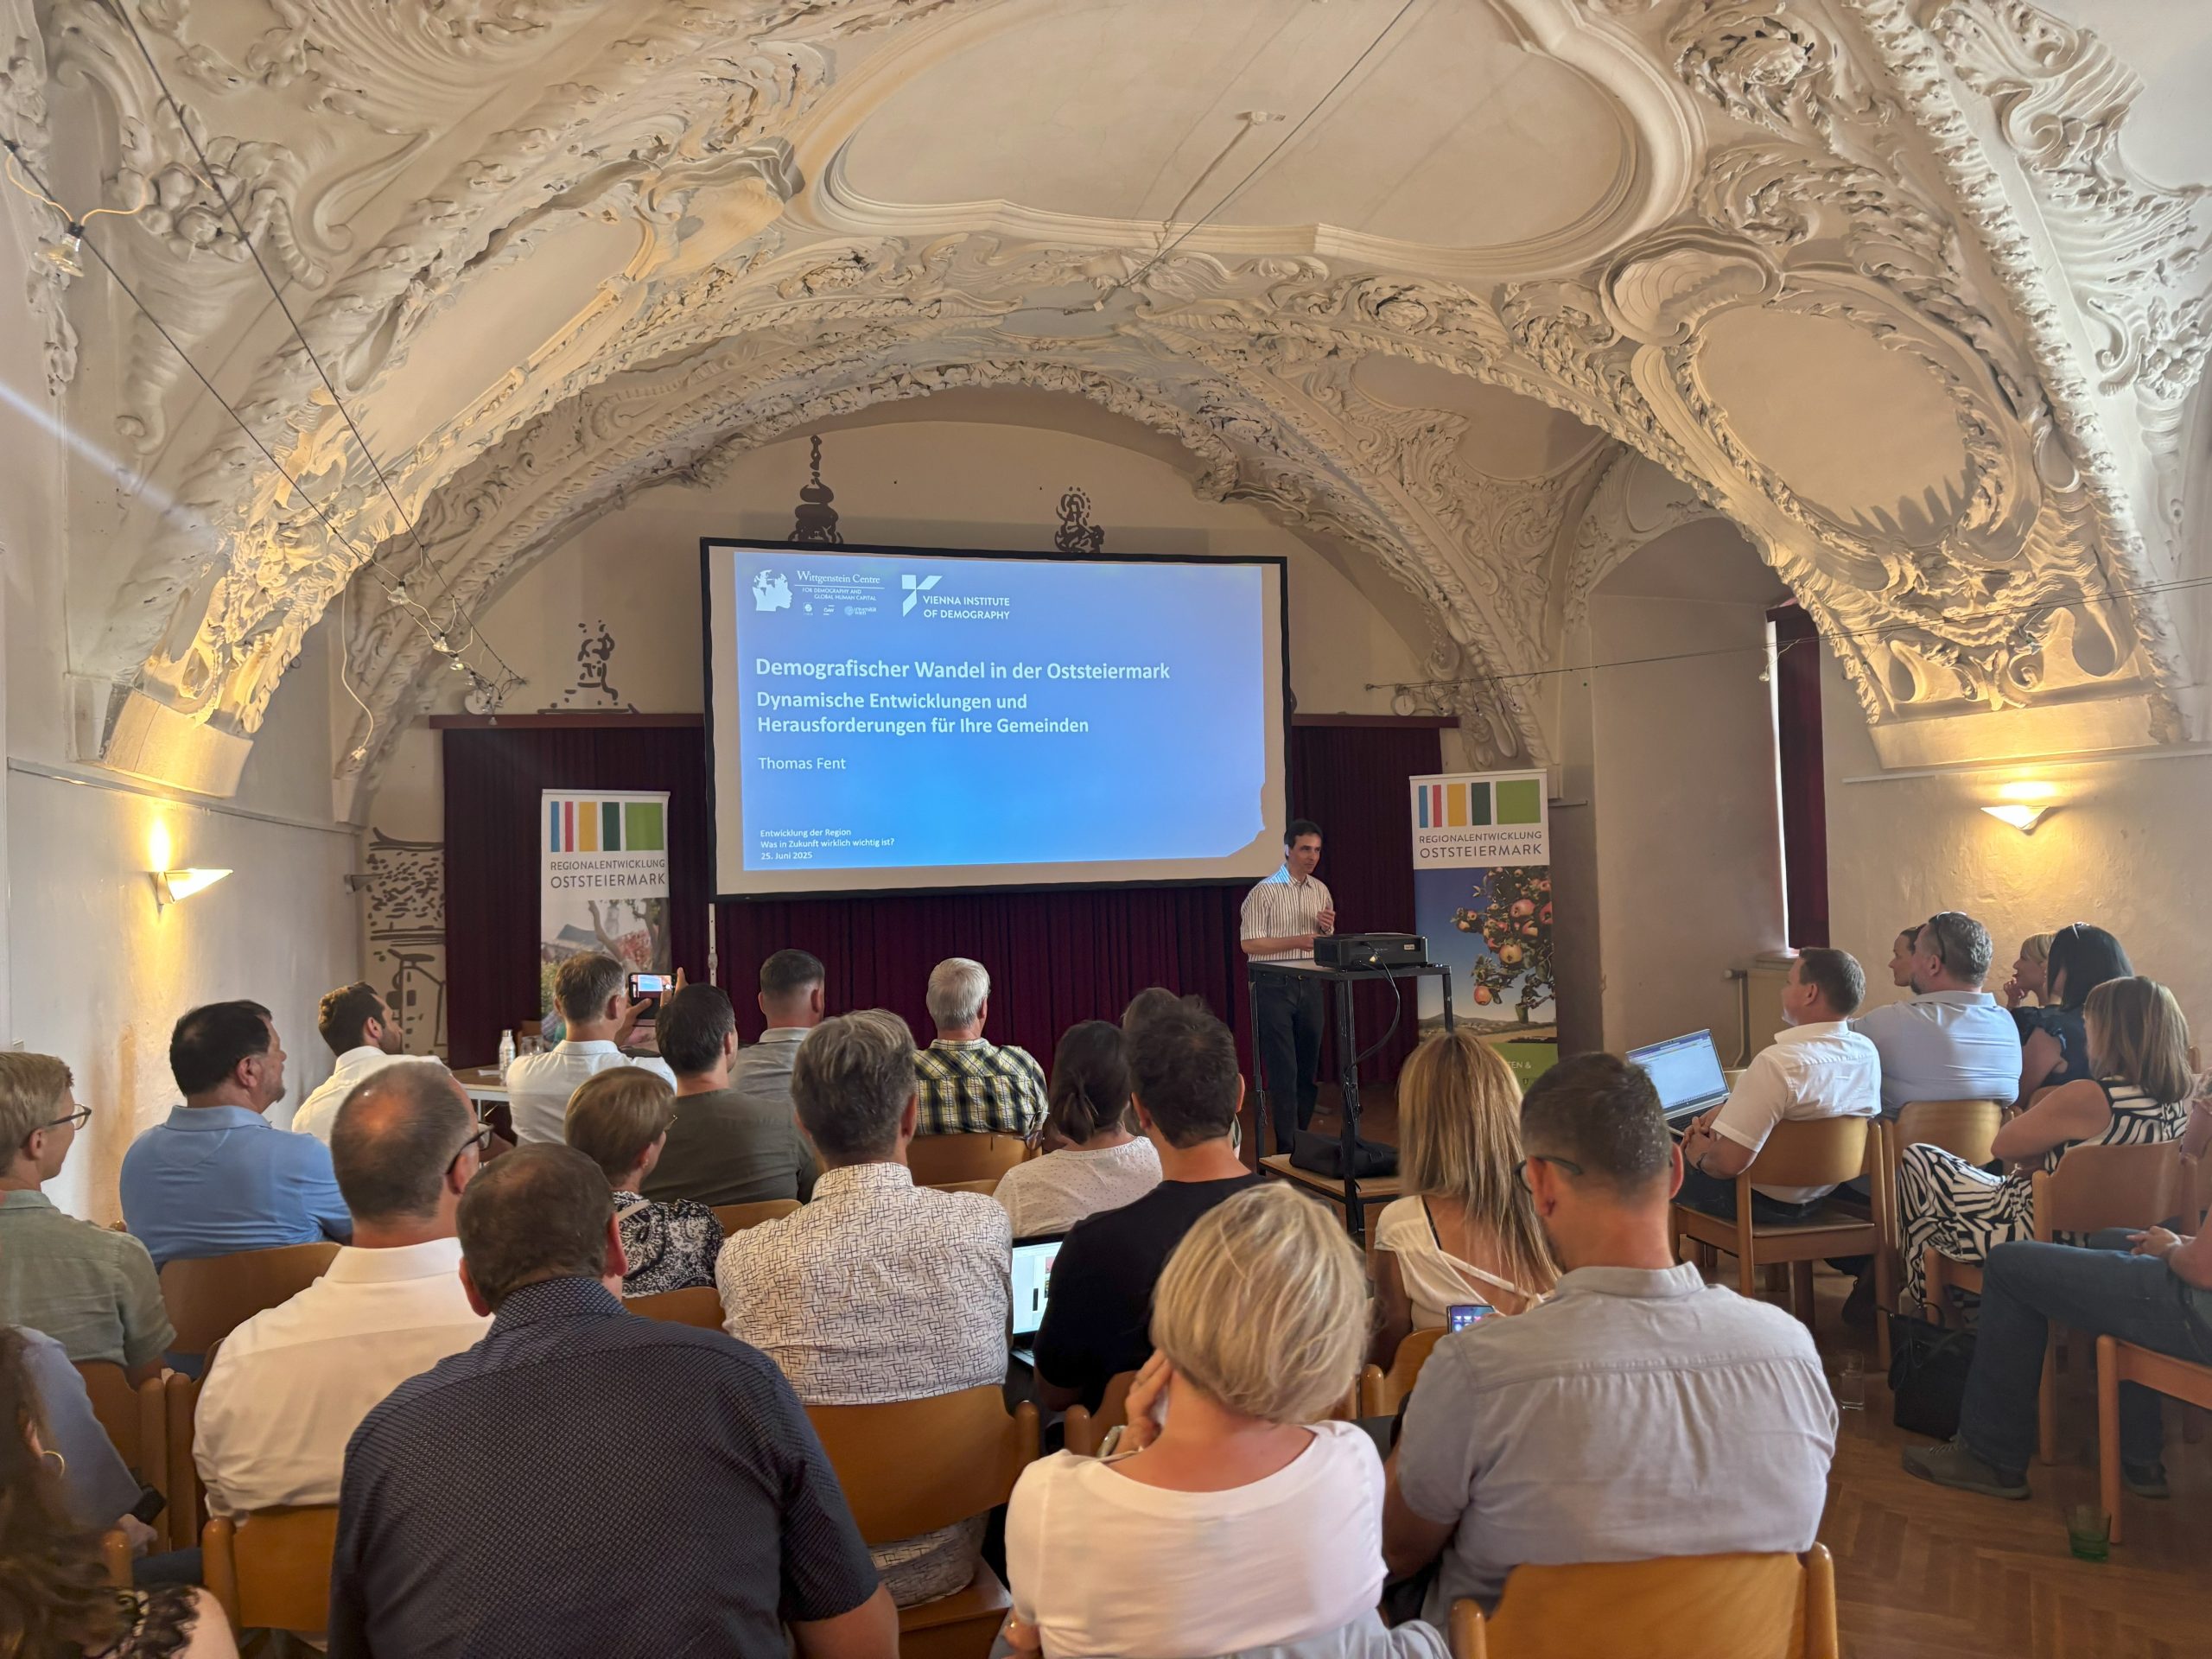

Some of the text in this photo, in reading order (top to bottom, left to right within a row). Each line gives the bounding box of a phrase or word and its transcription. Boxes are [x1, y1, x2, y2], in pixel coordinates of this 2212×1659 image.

[797, 570, 880, 584] Wittgenstein Centre
[923, 595, 1010, 607] VIENNA INSTITUTE
[923, 609, 1010, 620] OF DEMOGRAPHY
[756, 658, 1170, 680] Demografischer Wandel in der Oststeiermark
[757, 692, 1027, 712] Dynamische Entwicklungen und
[758, 716, 1089, 736] Herausforderungen für Ihre Gemeinden
[758, 757, 846, 770] Thomas Fent
[760, 830, 808, 838] Entwicklung
[825, 829, 852, 837] Region
[1419, 830, 1542, 843] REGIONALENTWICKLUNG
[852, 838, 880, 848] wichtig
[775, 851, 791, 860] Juni
[1420, 843, 1542, 859] OSTSTEIERMARK
[550, 859, 665, 871] REGIONALENTWICKLUNG
[550, 873, 665, 889] OSTSTEIERMARK
